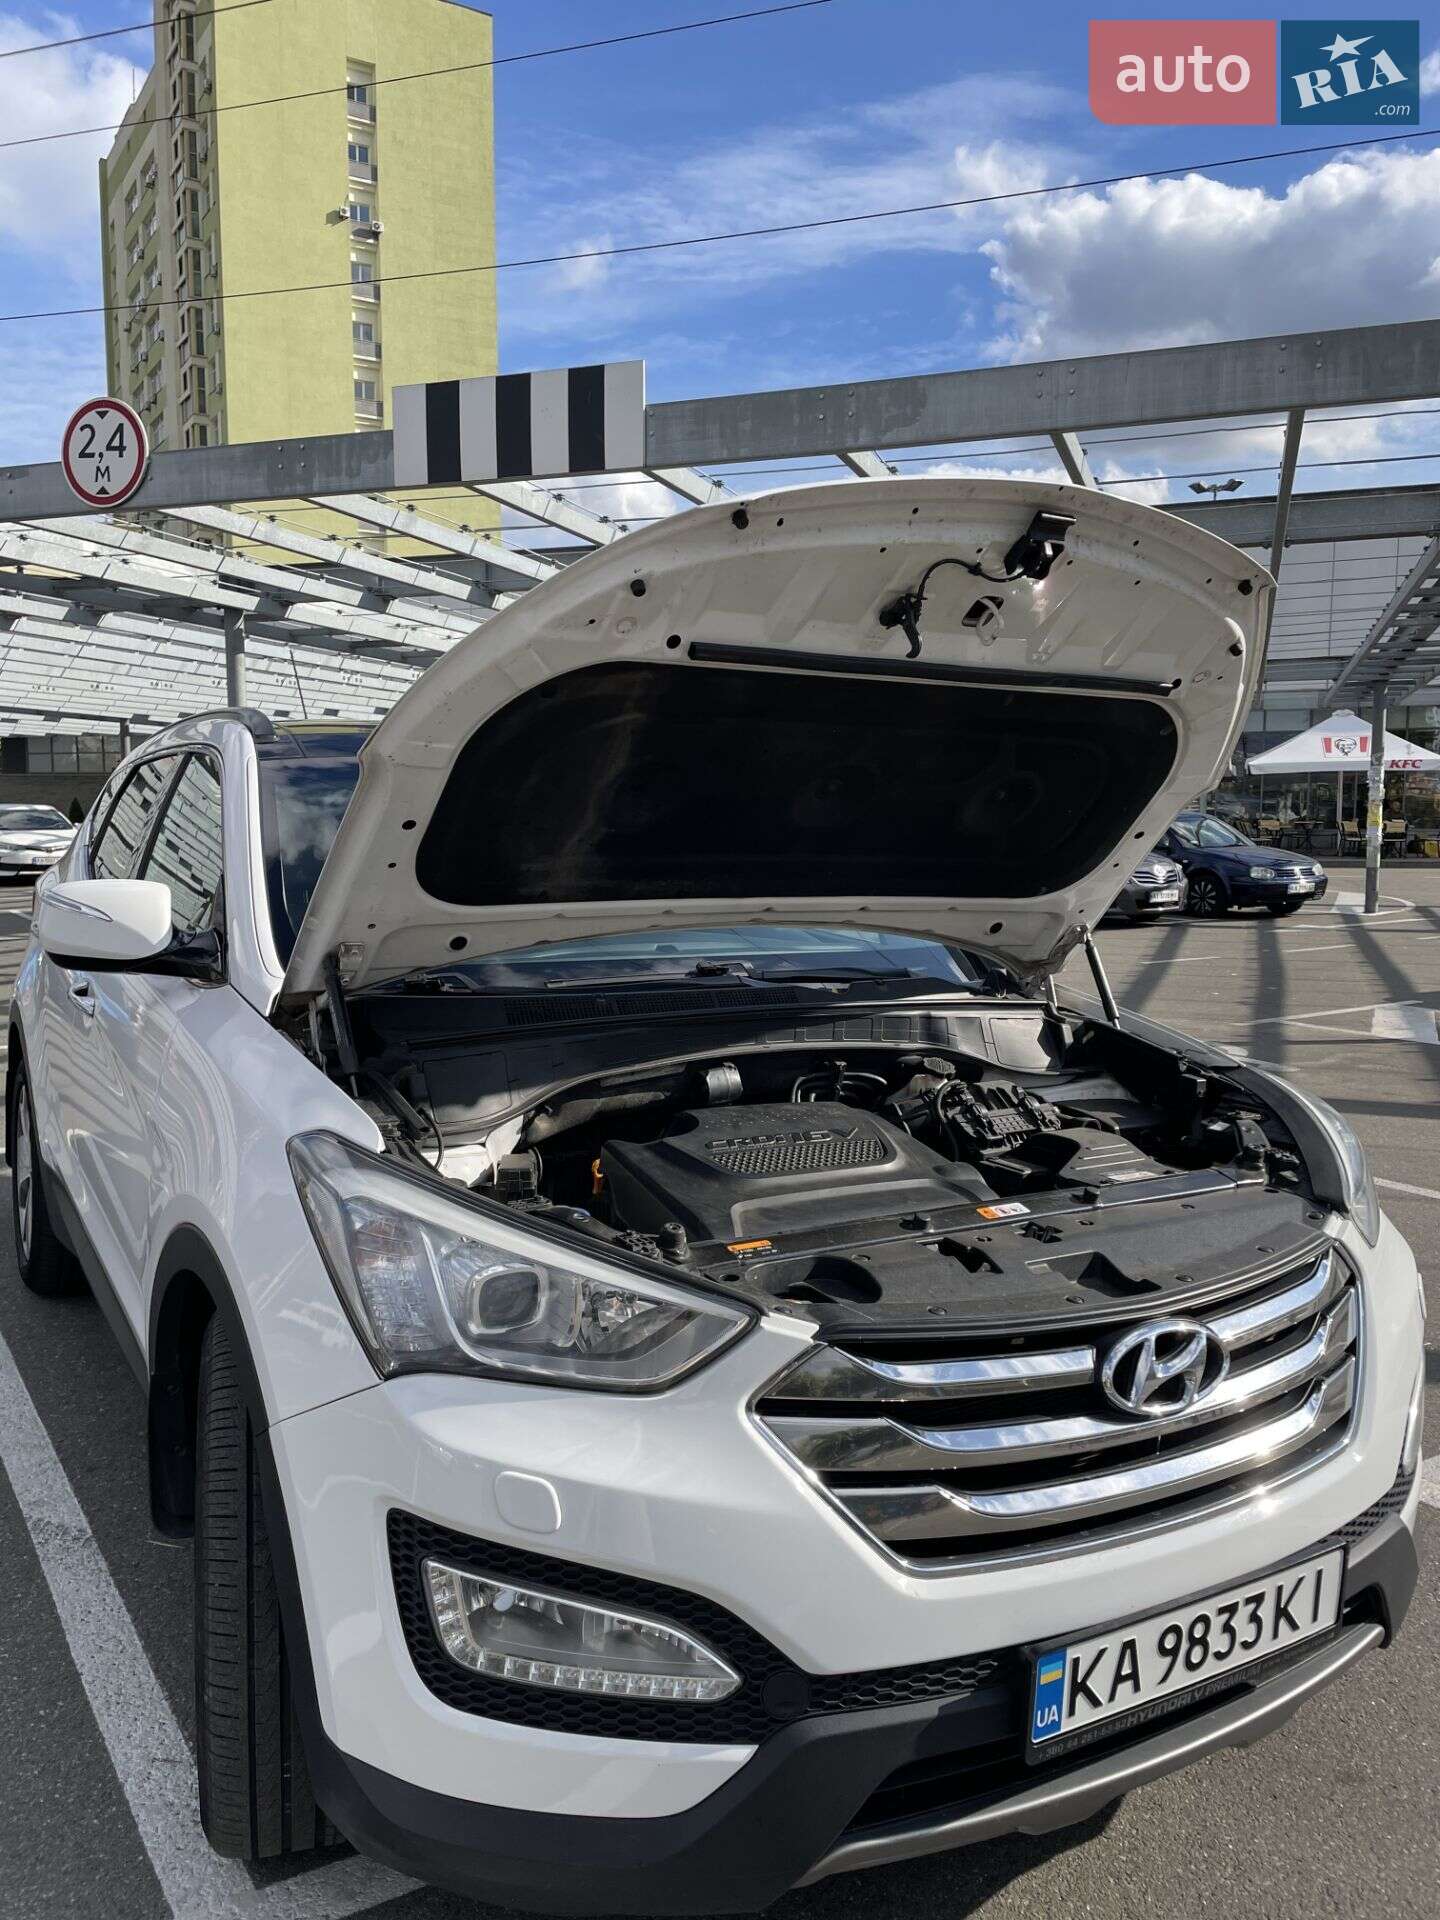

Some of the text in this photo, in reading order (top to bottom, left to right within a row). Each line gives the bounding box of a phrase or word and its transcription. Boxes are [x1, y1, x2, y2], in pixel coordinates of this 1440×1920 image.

[78, 423, 127, 463] 2,4
[1389, 759, 1423, 769] KFC
[1156, 1590, 1266, 1686] 9833
[1036, 1704, 1059, 1728] UA
